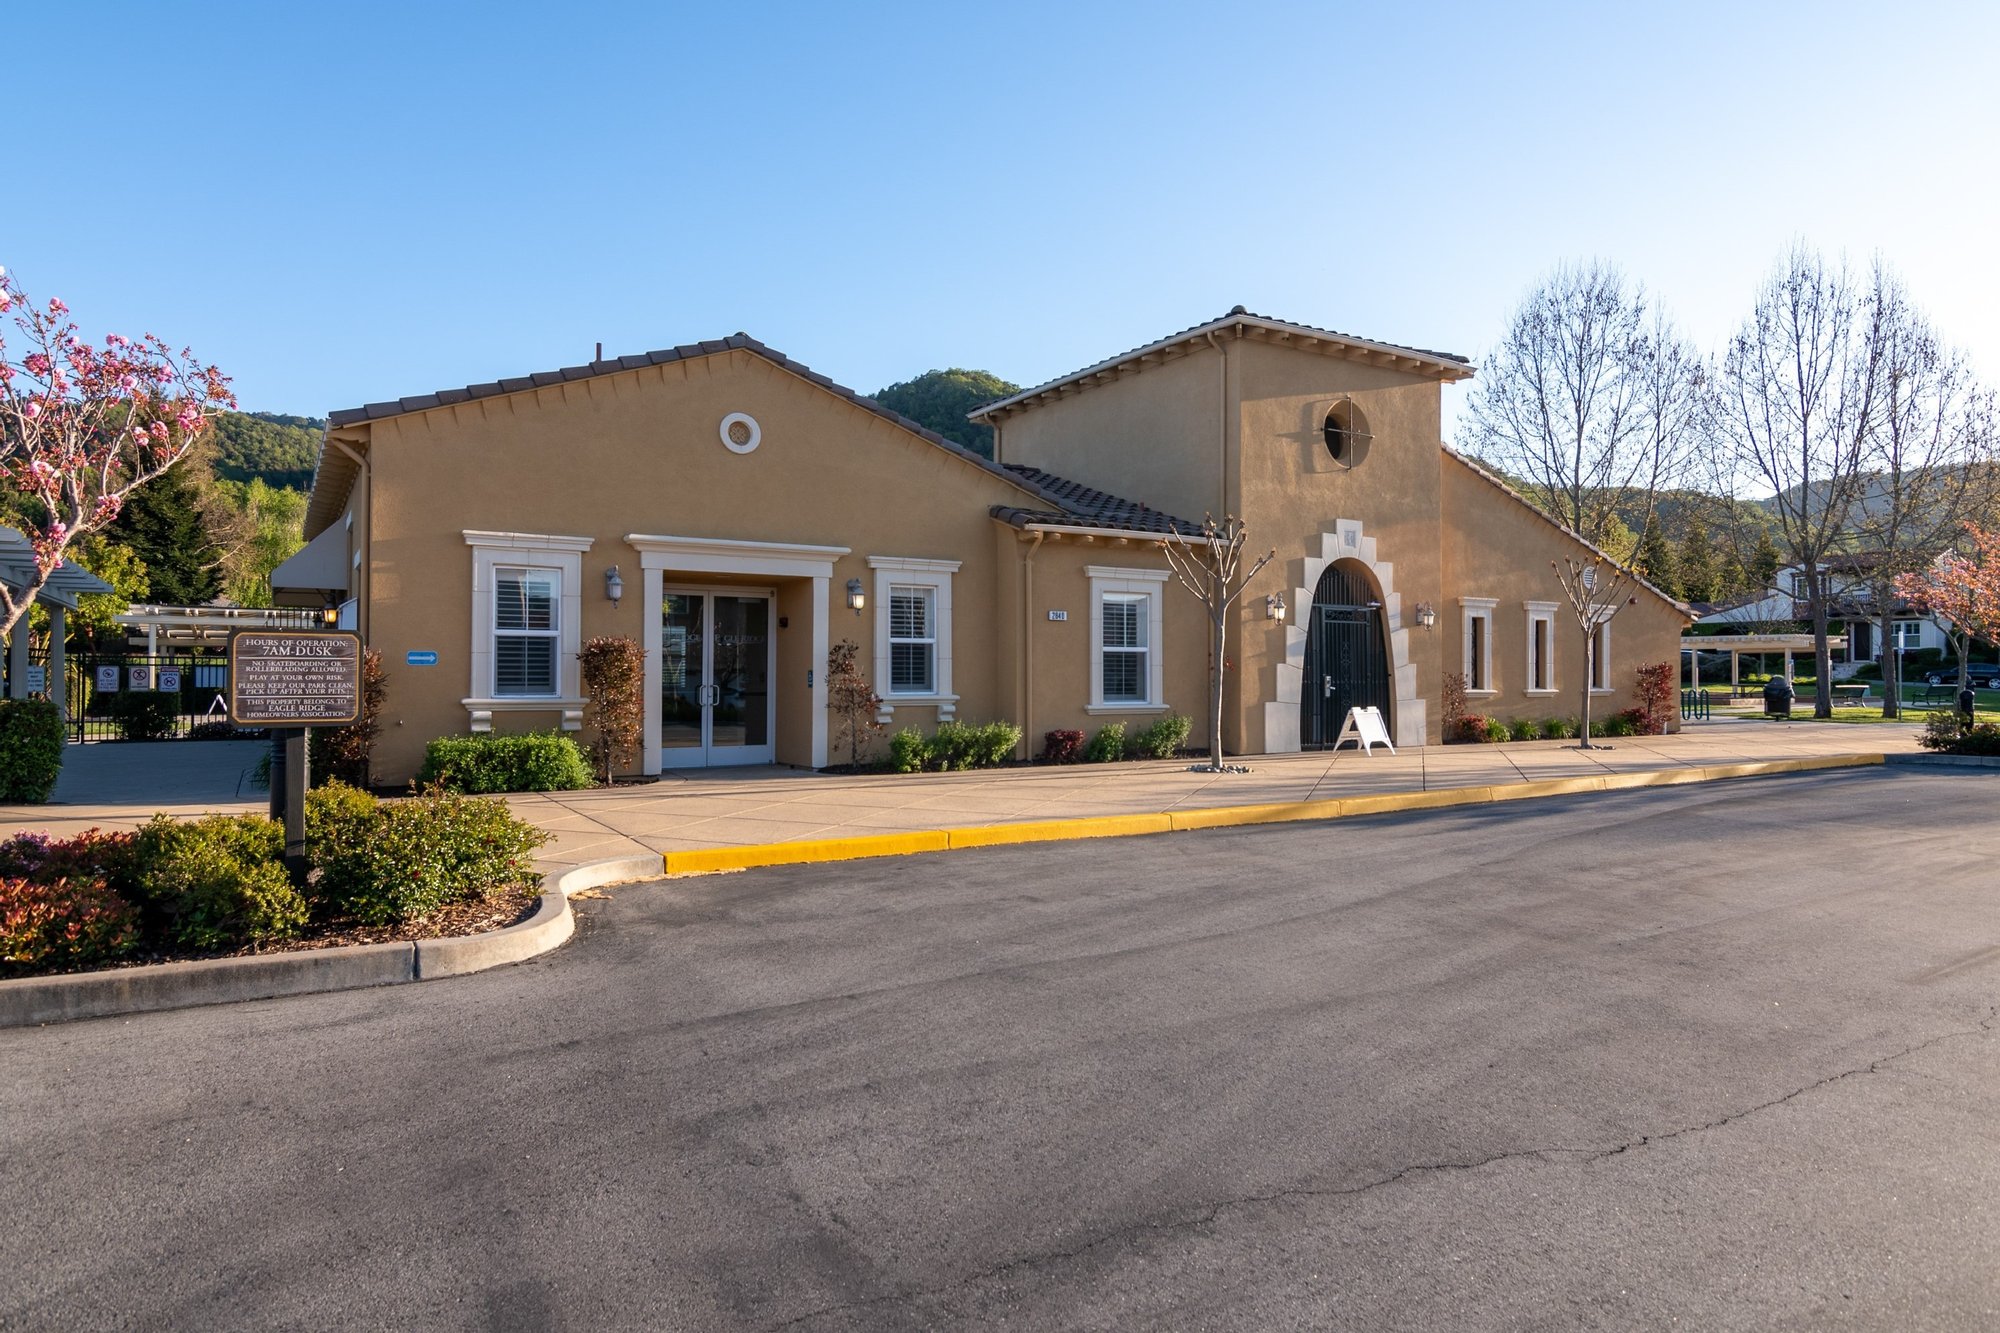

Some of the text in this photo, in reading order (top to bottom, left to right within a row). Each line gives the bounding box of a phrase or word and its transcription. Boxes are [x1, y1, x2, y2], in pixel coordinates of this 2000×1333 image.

[246, 639, 348, 647] HOURS OF OPERATION:
[263, 646, 332, 656] 7AM-DUSK
